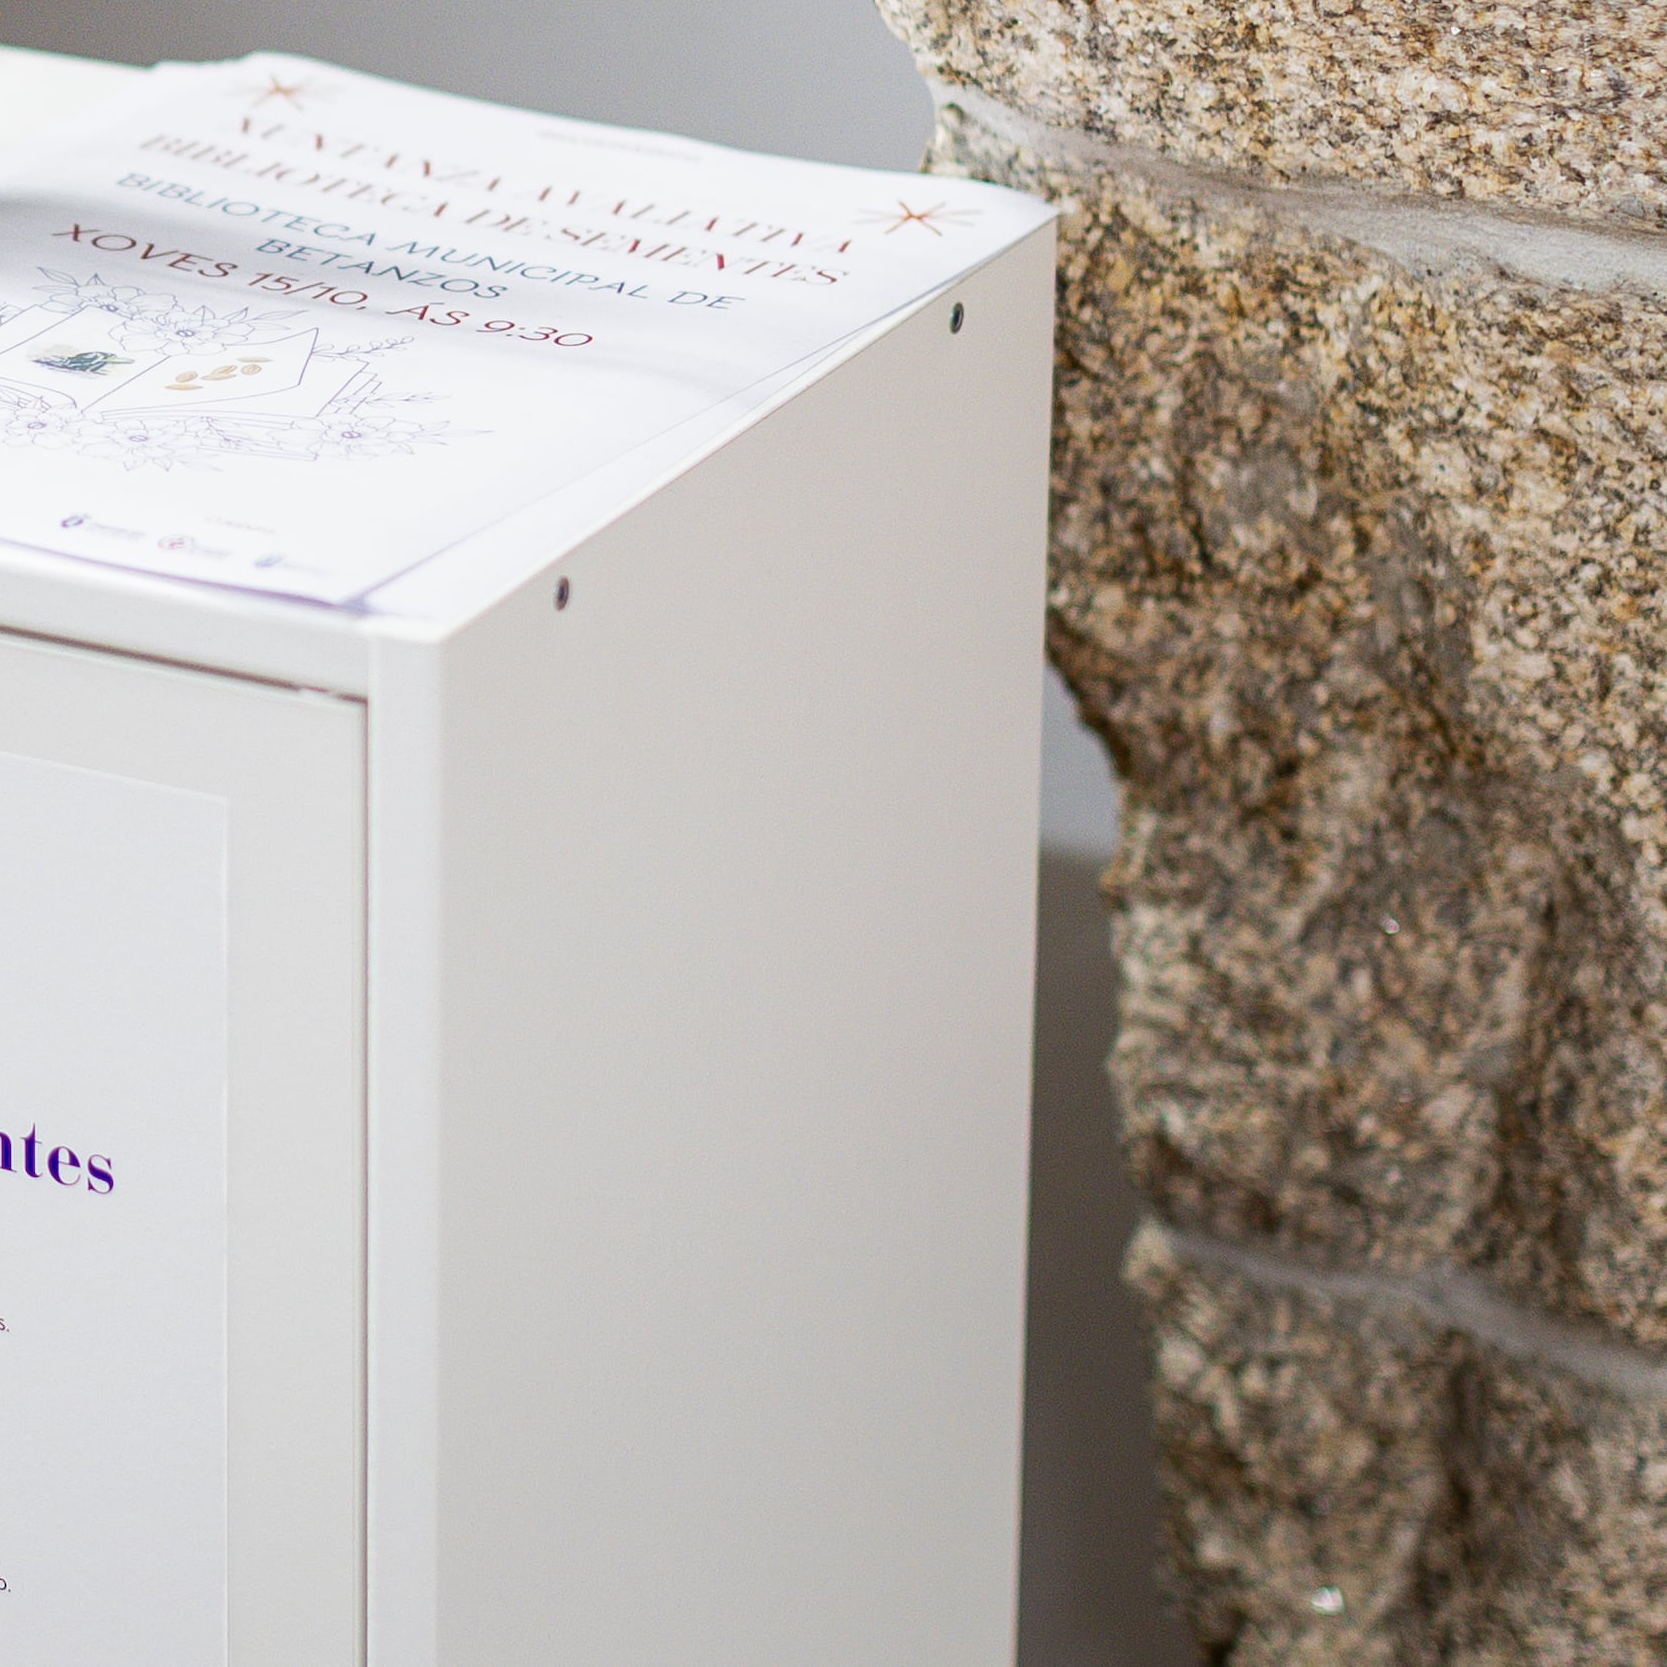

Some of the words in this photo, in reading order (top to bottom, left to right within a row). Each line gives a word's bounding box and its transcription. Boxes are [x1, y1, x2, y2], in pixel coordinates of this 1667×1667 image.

[51, 223, 240, 280] XOVES
[247, 271, 369, 311] 15/10,
[385, 301, 471, 327] ÁS
[476, 319, 594, 348] 9:30
[115, 172, 377, 246] BIBLIOTECA
[386, 240, 649, 300] MUNICIPAL
[667, 290, 747, 311] DE
[255, 238, 509, 300] BETANZOS
